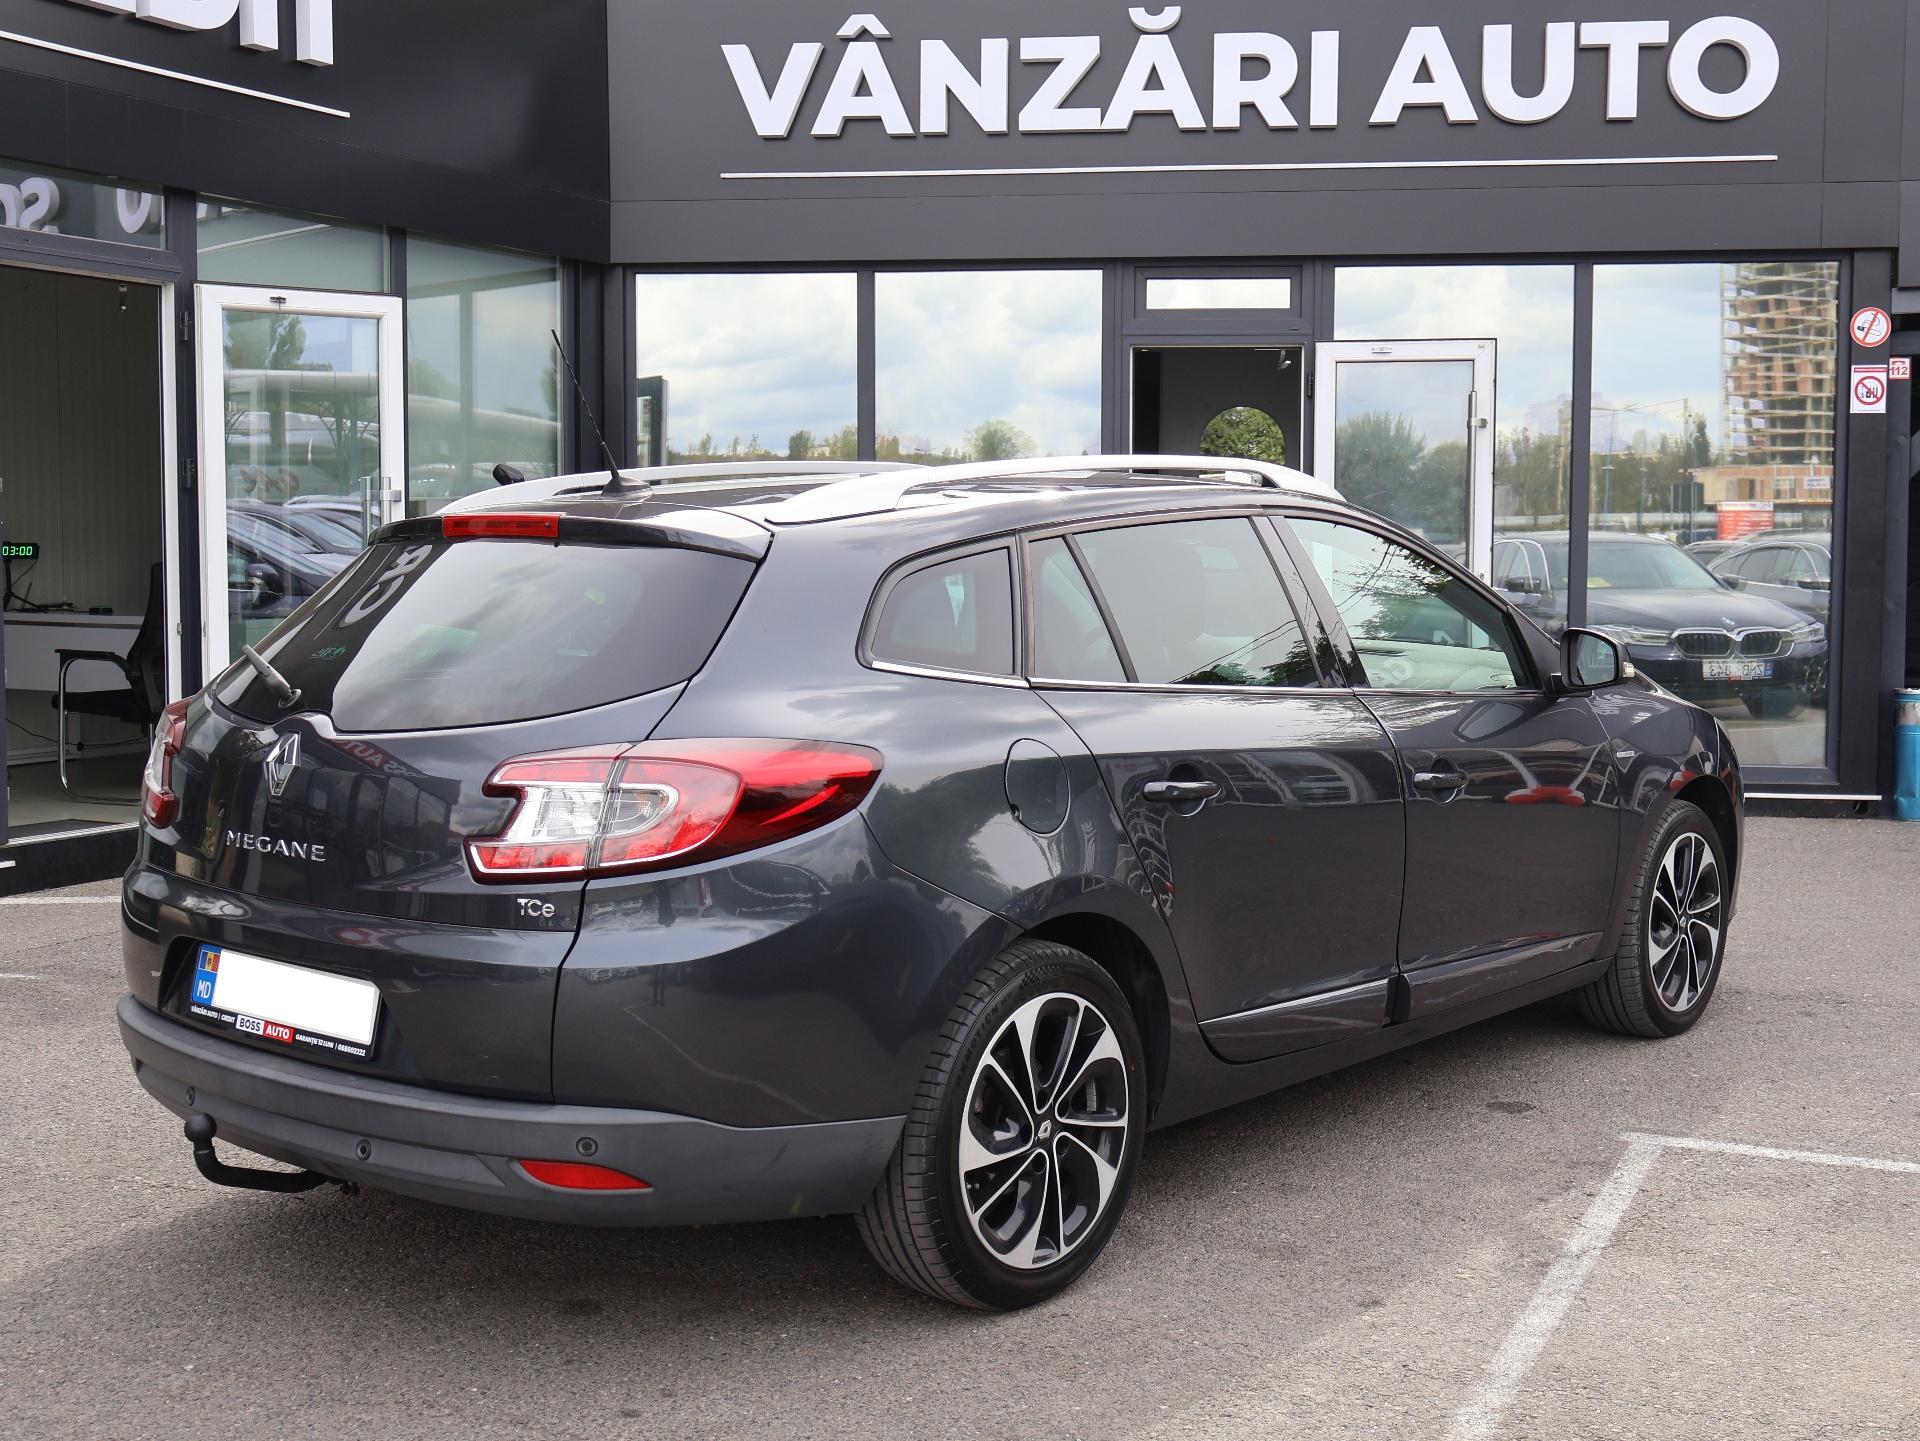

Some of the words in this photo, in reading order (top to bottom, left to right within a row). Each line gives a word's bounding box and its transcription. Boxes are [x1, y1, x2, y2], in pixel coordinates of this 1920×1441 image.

[720, 6, 1341, 140] VÂNZĂRI
[1368, 15, 1781, 127] AUTO
[1889, 366, 1909, 376] 112
[2, 546, 33, 556] 03:00
[225, 830, 326, 861] MEGANE
[516, 898, 555, 918] TCe
[196, 979, 212, 998] MD
[239, 1017, 261, 1032] BOSS
[265, 1024, 290, 1040] AUTO
